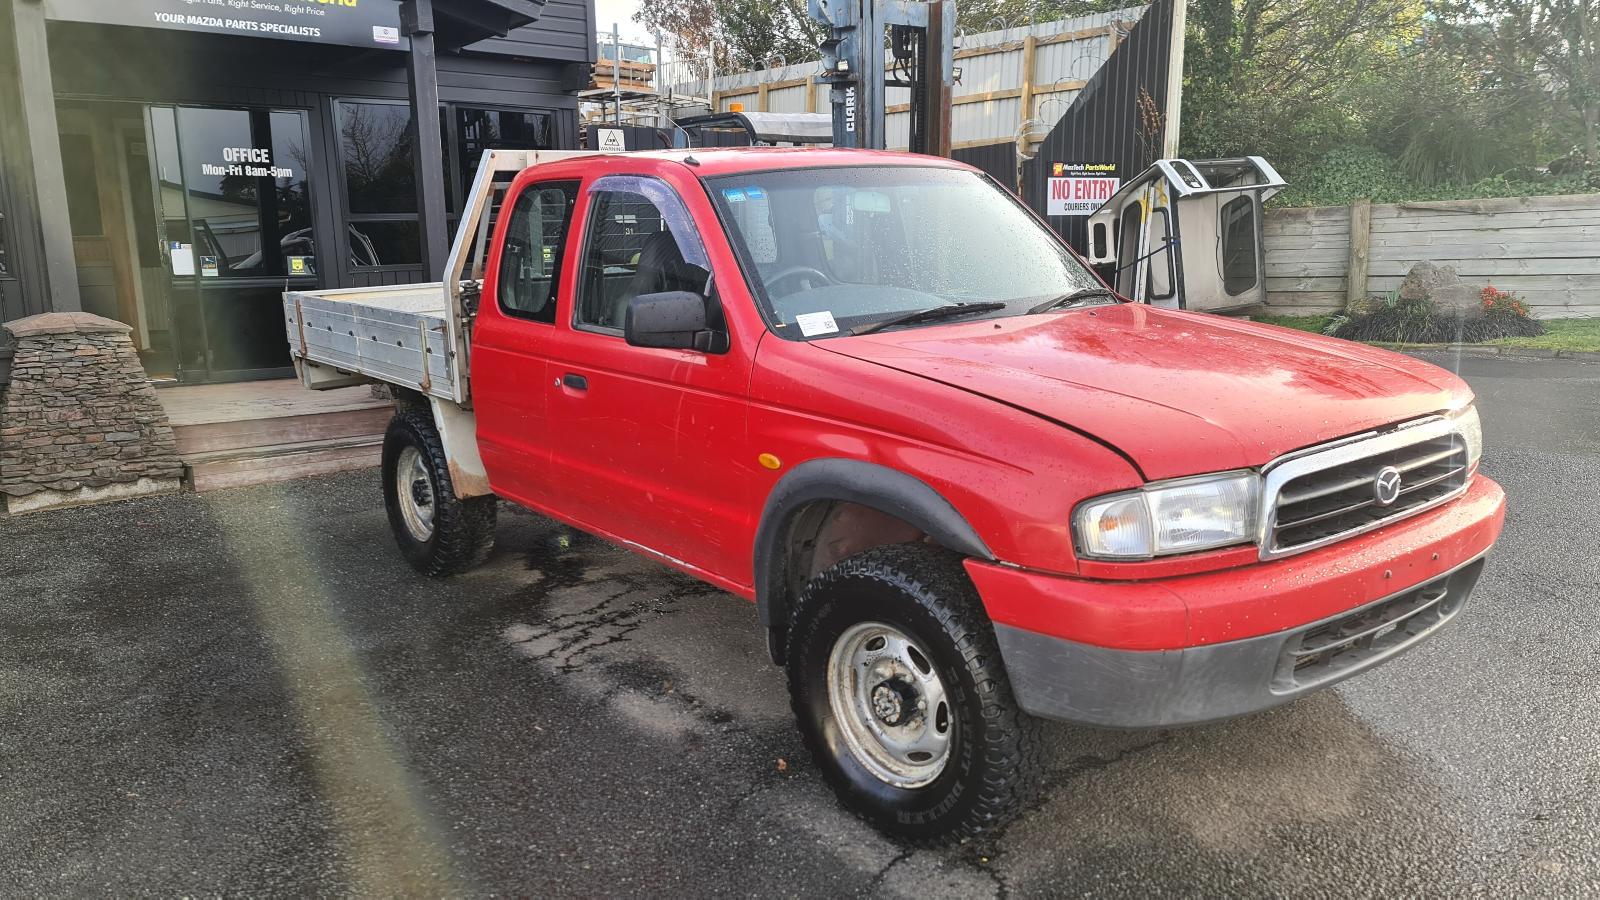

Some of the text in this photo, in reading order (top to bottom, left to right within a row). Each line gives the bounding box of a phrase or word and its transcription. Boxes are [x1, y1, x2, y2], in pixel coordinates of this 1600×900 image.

[228, 0, 249, 8] Right
[251, 1, 282, 13] Service,
[284, 4, 304, 14] Right
[306, 6, 325, 16] Price
[154, 12, 321, 36] YOUR MAZDA PARTS SPECIALISTS
[846, 86, 855, 132] CLARK
[223, 147, 270, 163] OFFICE
[202, 164, 293, 178] Mon-Fri 8am-5pm
[1052, 180, 1115, 200] NO ENTRY
[1064, 202, 1090, 210] COURIERS
